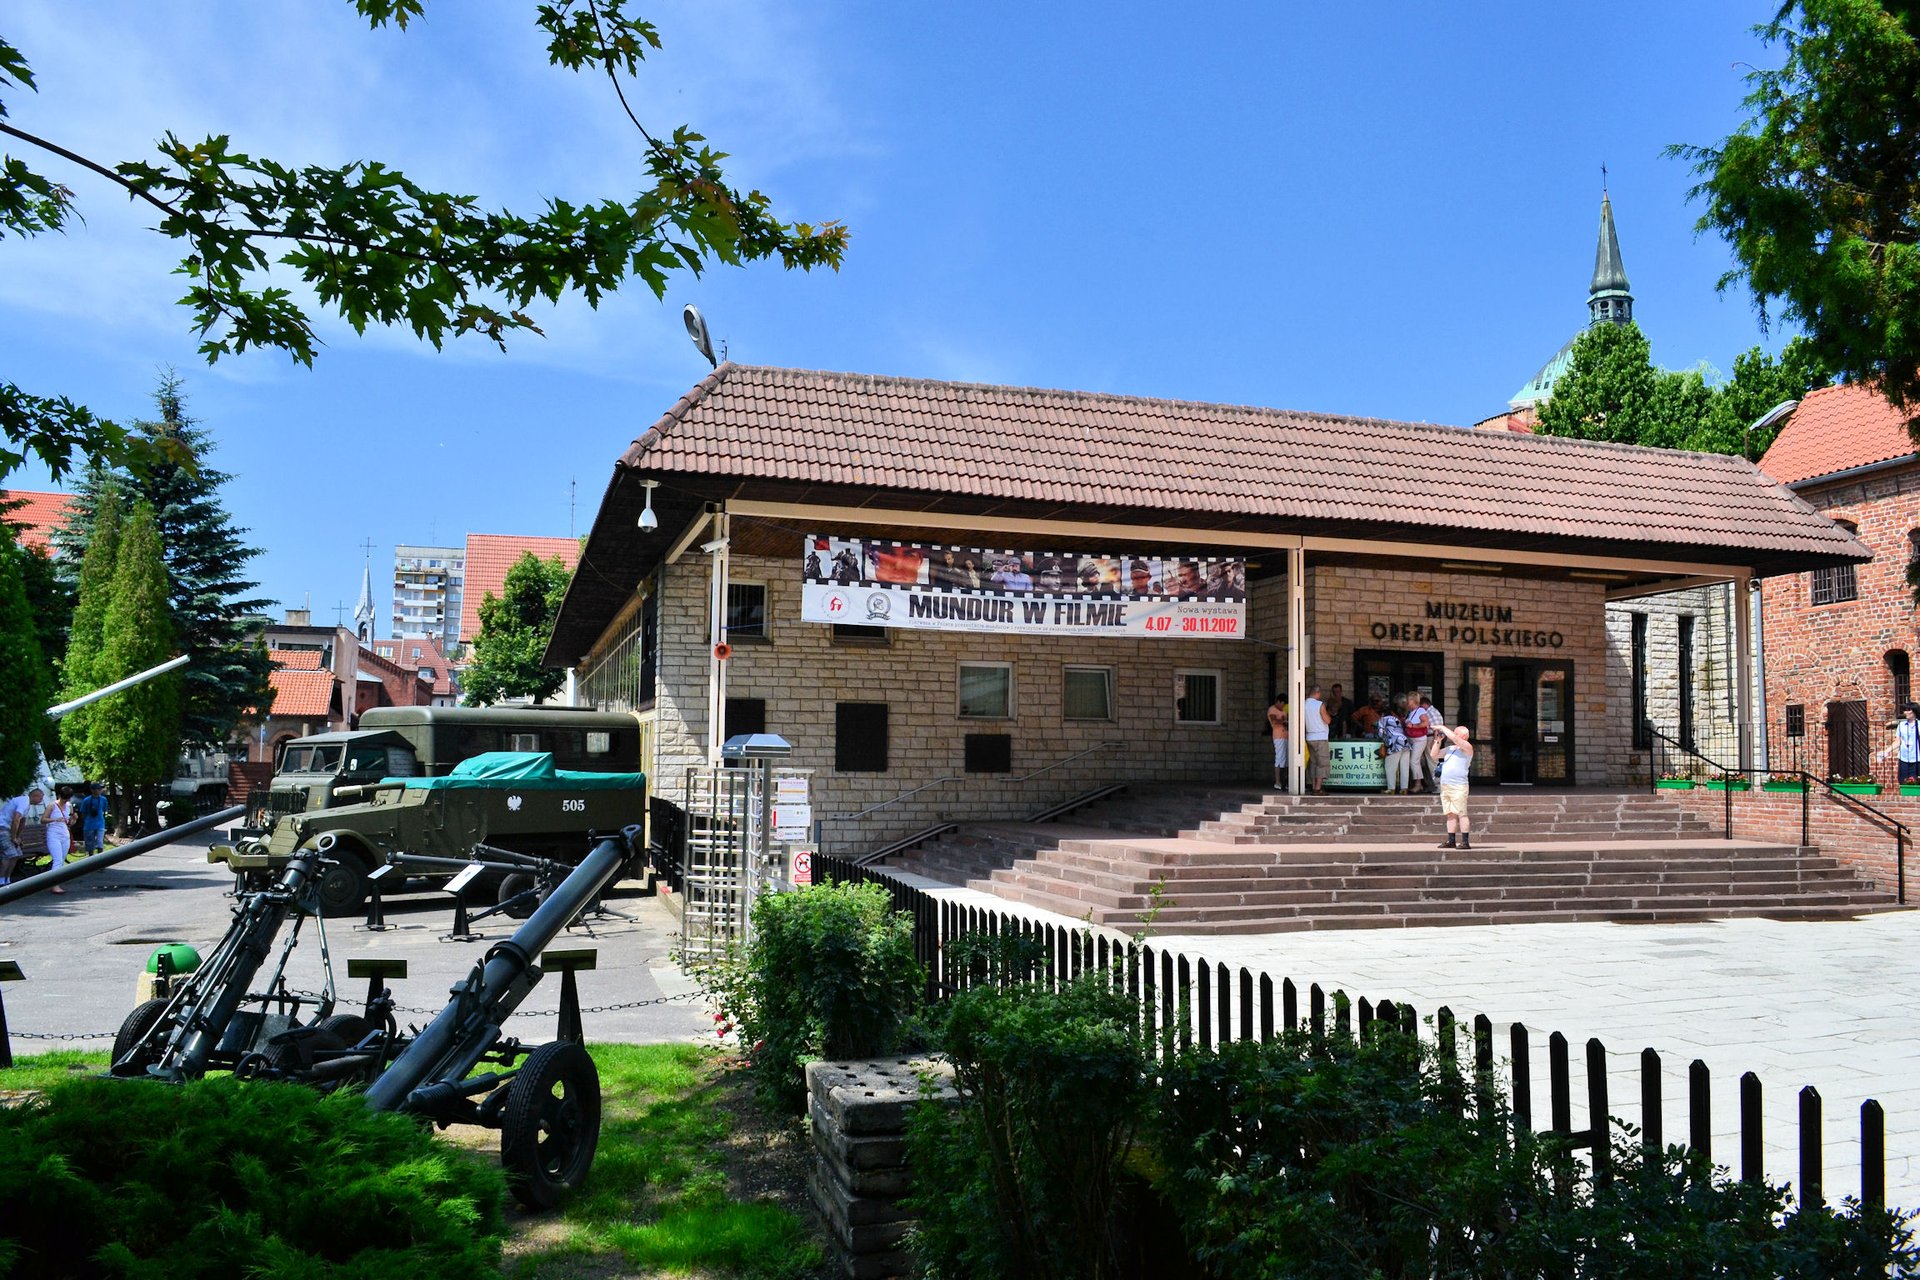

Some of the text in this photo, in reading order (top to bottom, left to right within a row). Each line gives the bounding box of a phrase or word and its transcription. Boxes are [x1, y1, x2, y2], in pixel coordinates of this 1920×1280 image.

[909, 594, 1014, 623] MUNDUR
[1022, 601, 1047, 624] W
[1054, 602, 1128, 627] FILMIE
[1177, 606, 1238, 615] Nowa wystawa
[1425, 601, 1513, 623] MUZEUM
[1145, 616, 1172, 631] 4.07
[1182, 617, 1237, 633] 30.11.2012
[1450, 625, 1564, 649] POLSKIEGO
[562, 799, 585, 811] 505
